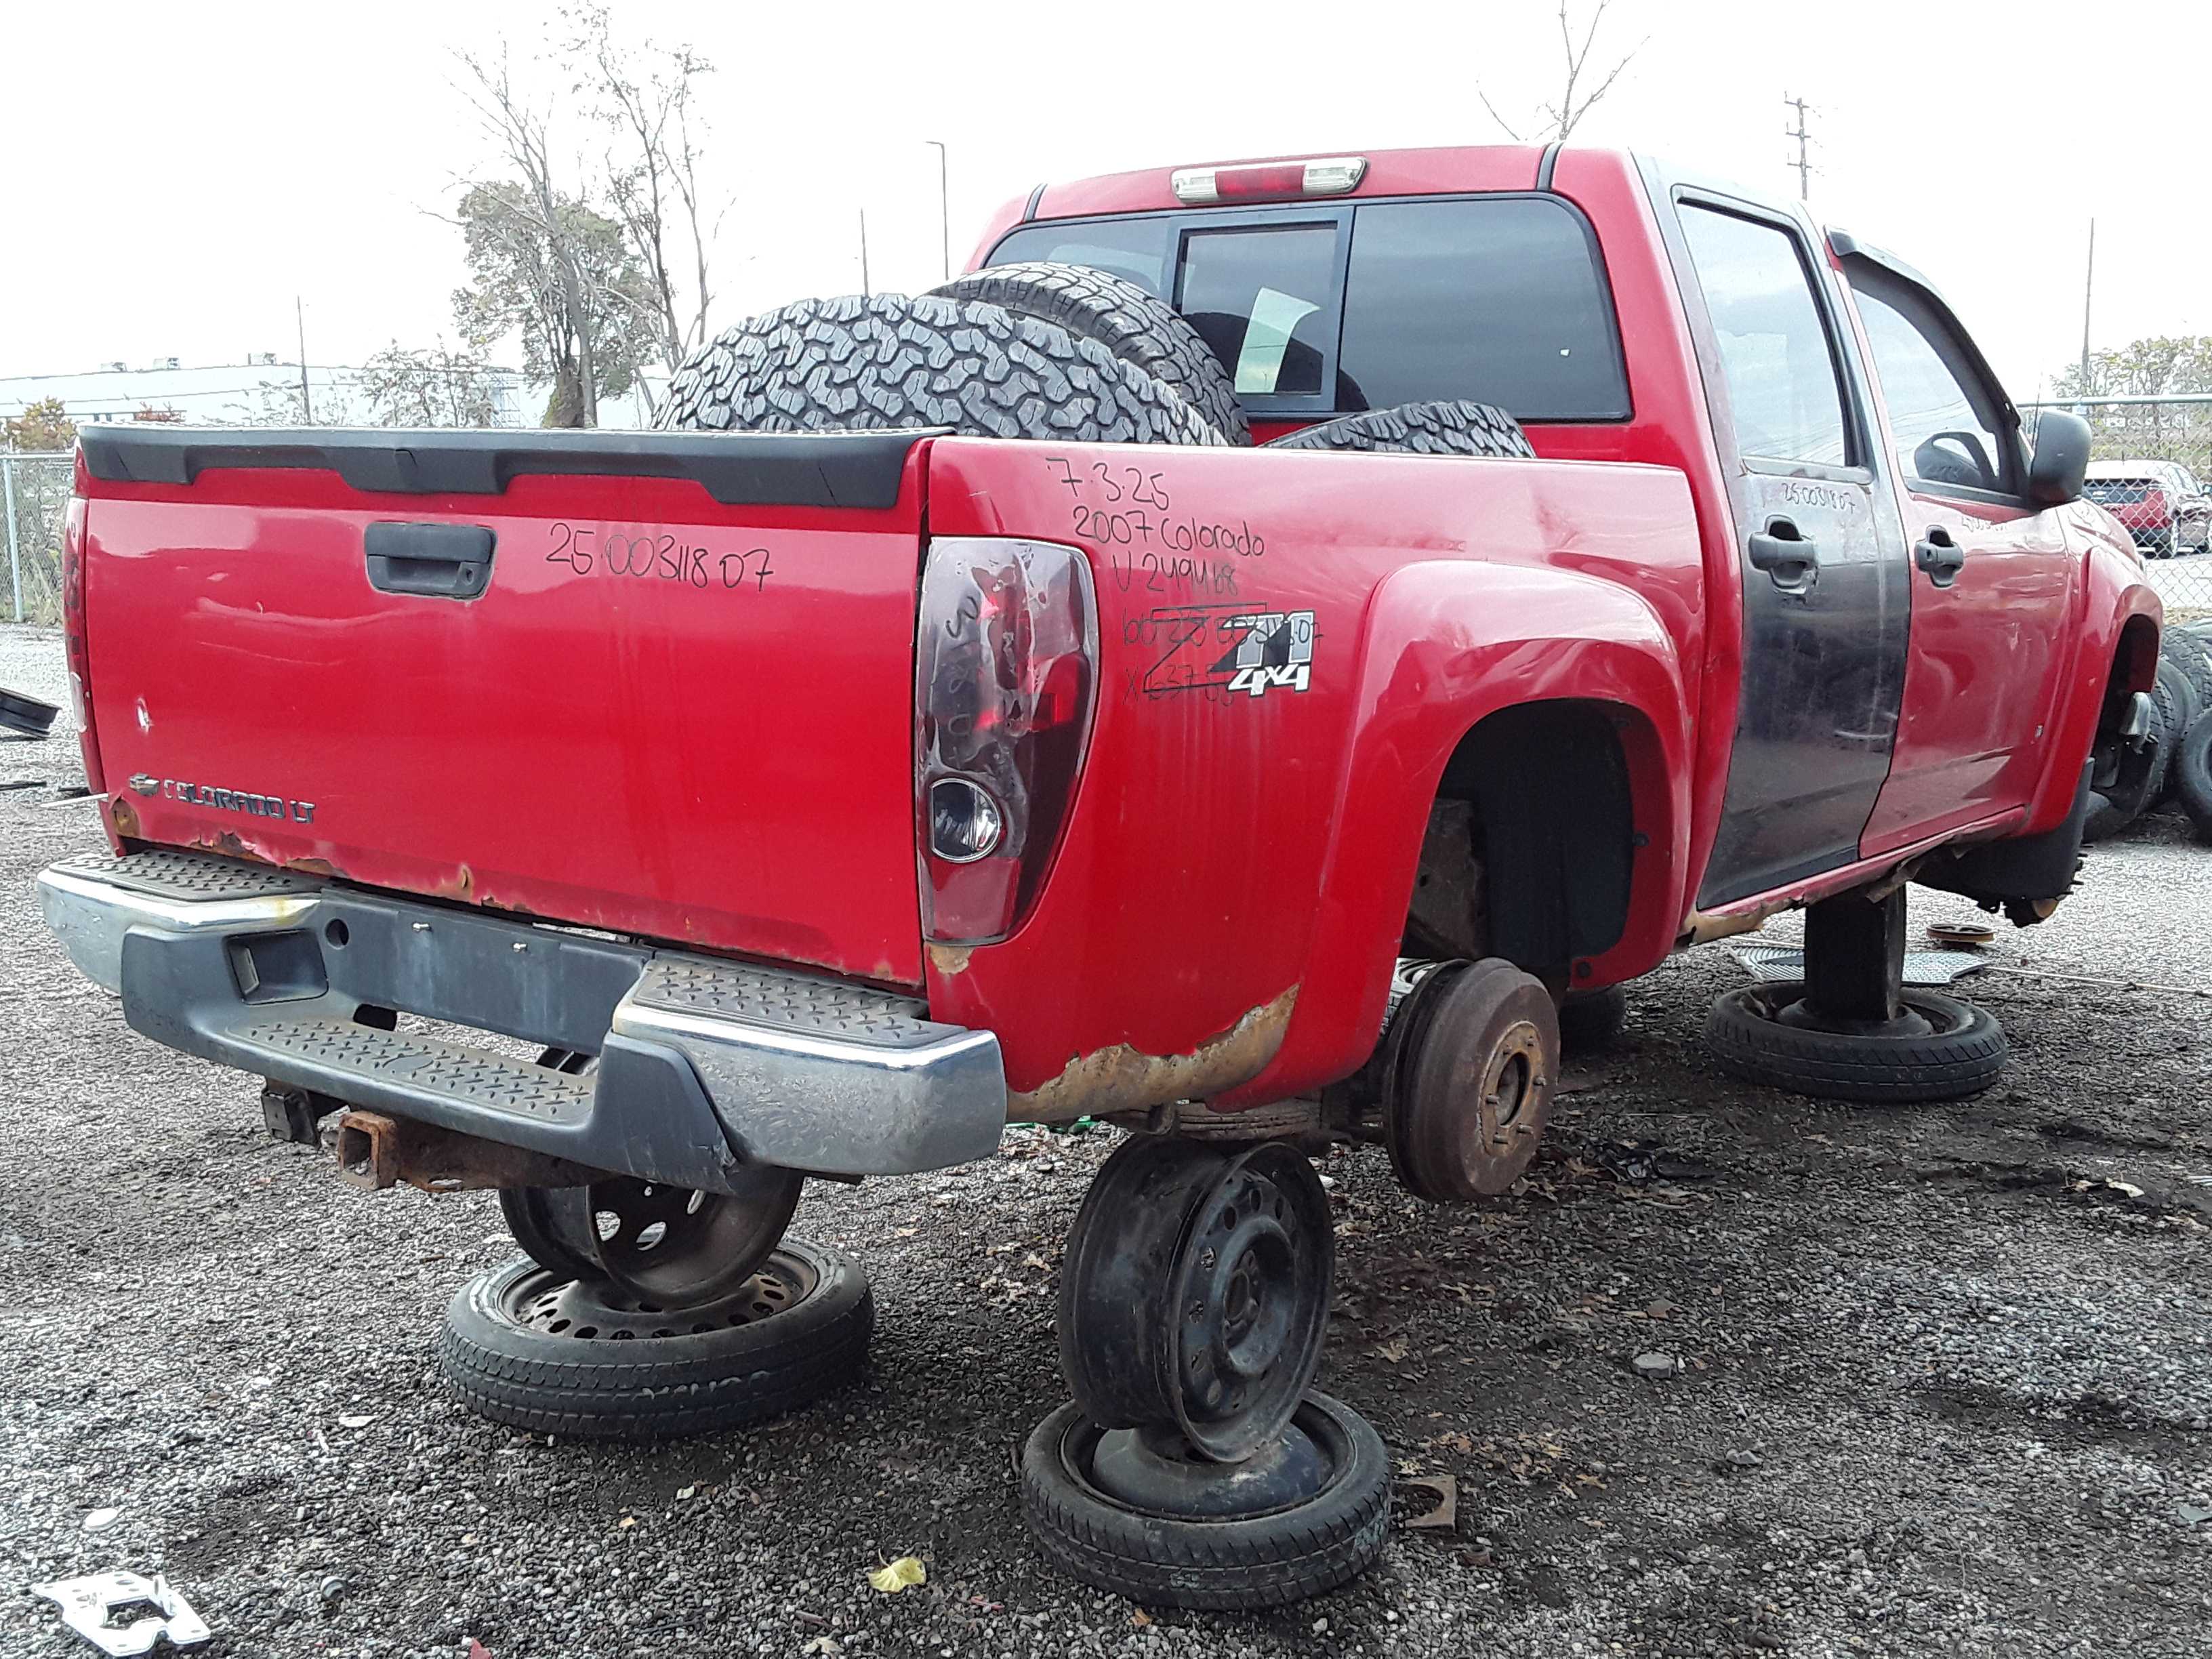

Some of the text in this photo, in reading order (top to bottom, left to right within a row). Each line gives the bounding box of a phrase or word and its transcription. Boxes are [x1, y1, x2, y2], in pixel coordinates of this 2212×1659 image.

[1073, 505, 1265, 557] 2007 Colorado
[163, 779, 316, 825] COLORADO LT
